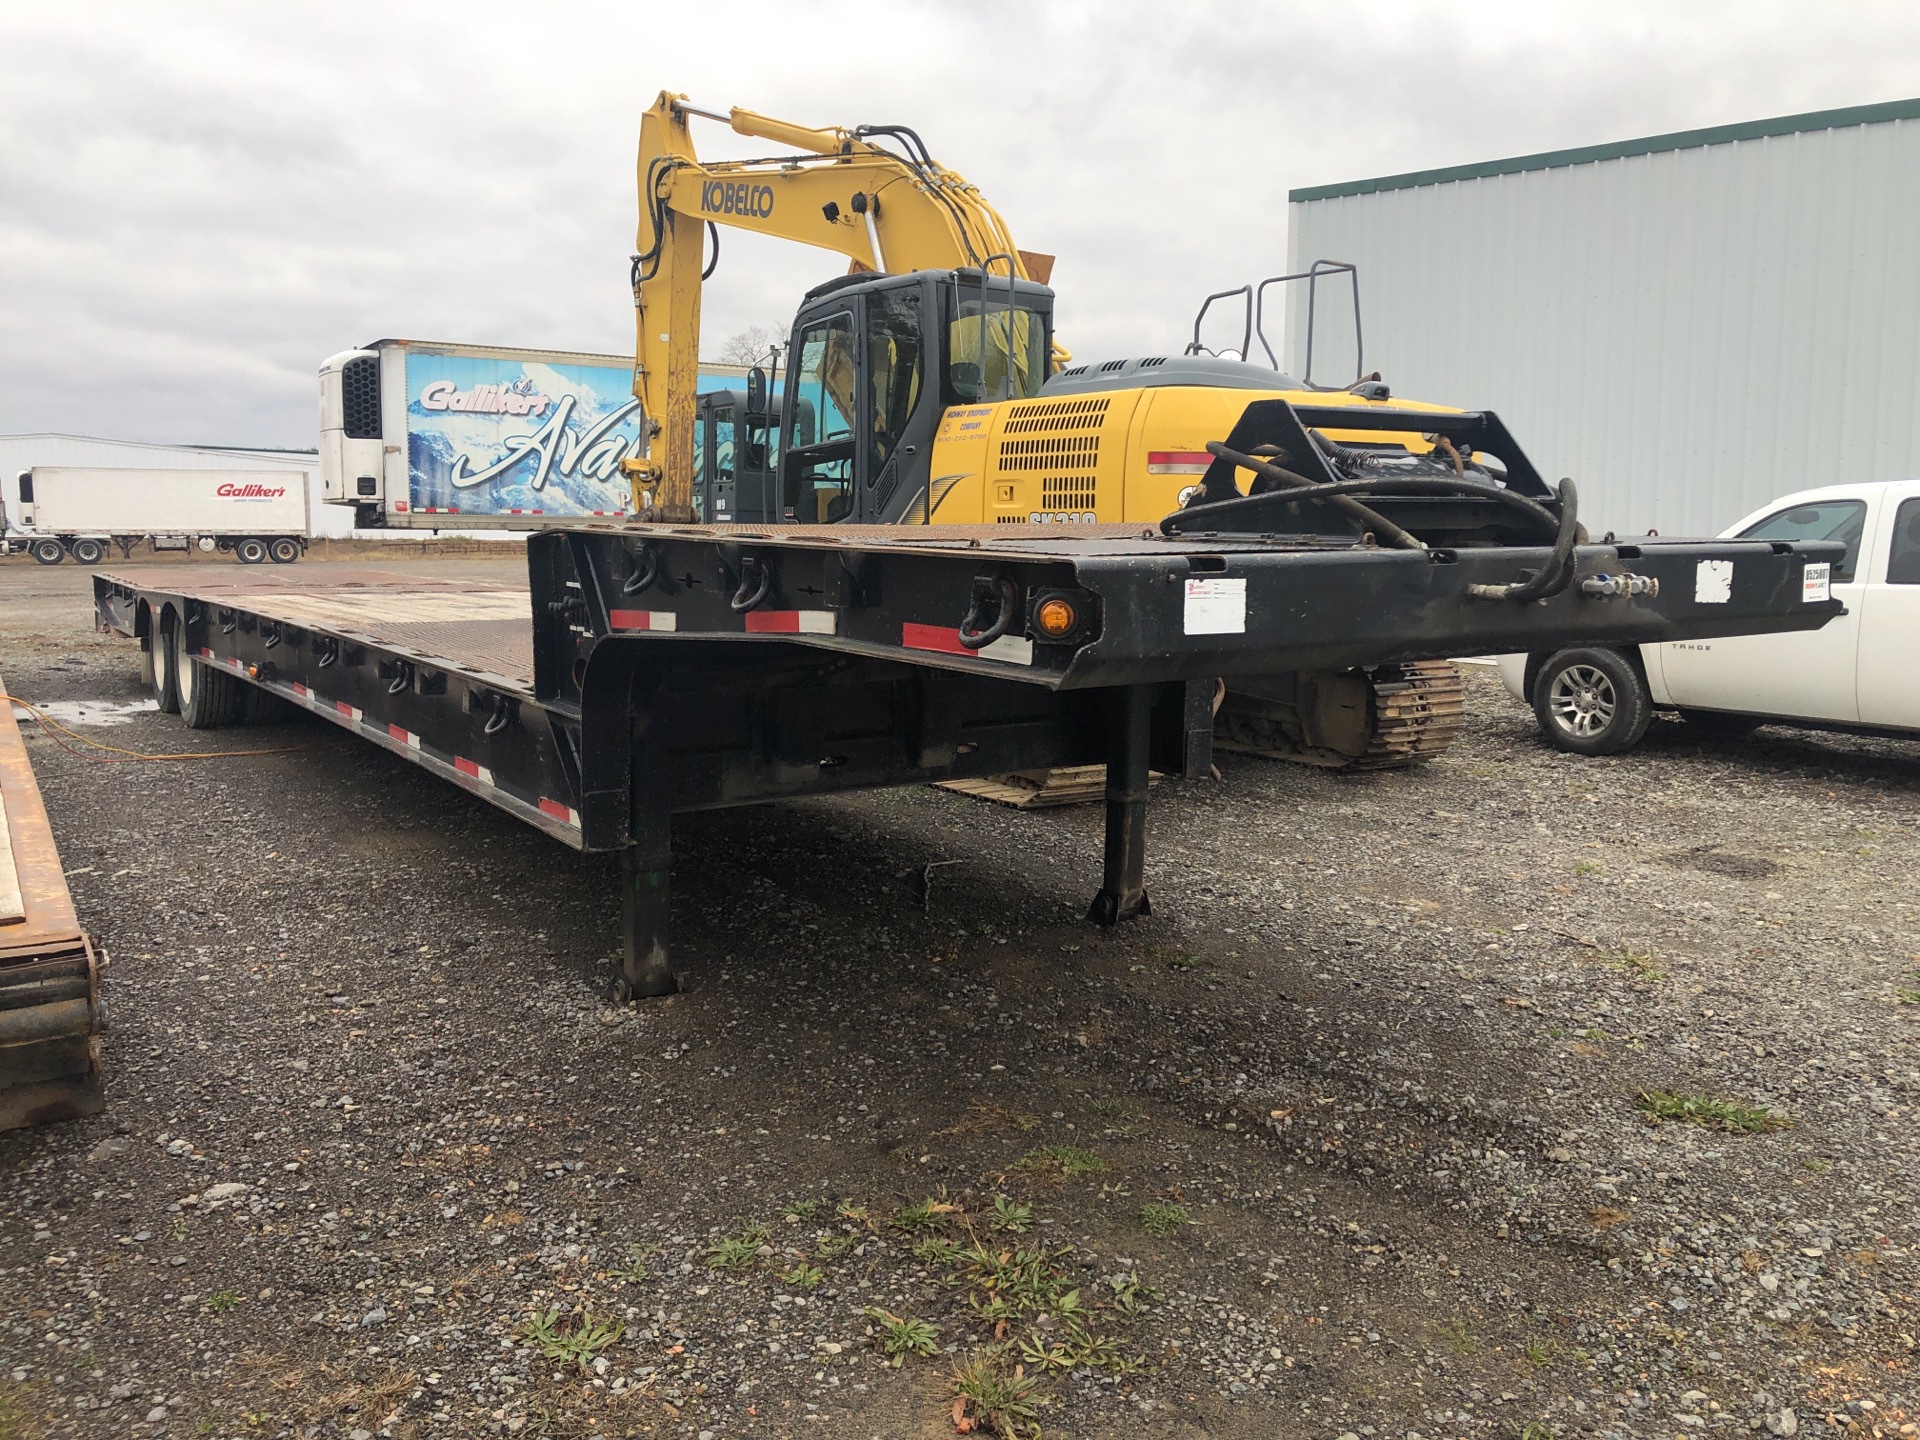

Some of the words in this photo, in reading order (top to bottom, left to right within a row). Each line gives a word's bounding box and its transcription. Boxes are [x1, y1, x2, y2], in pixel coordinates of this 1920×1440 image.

[701, 181, 774, 218] KOBELCO
[967, 408, 992, 417] EQUIPMENT
[960, 422, 982, 431] COMPANY
[451, 394, 641, 490] Ava
[216, 483, 286, 497] Galliker's
[1671, 643, 1711, 651] TAHOE
